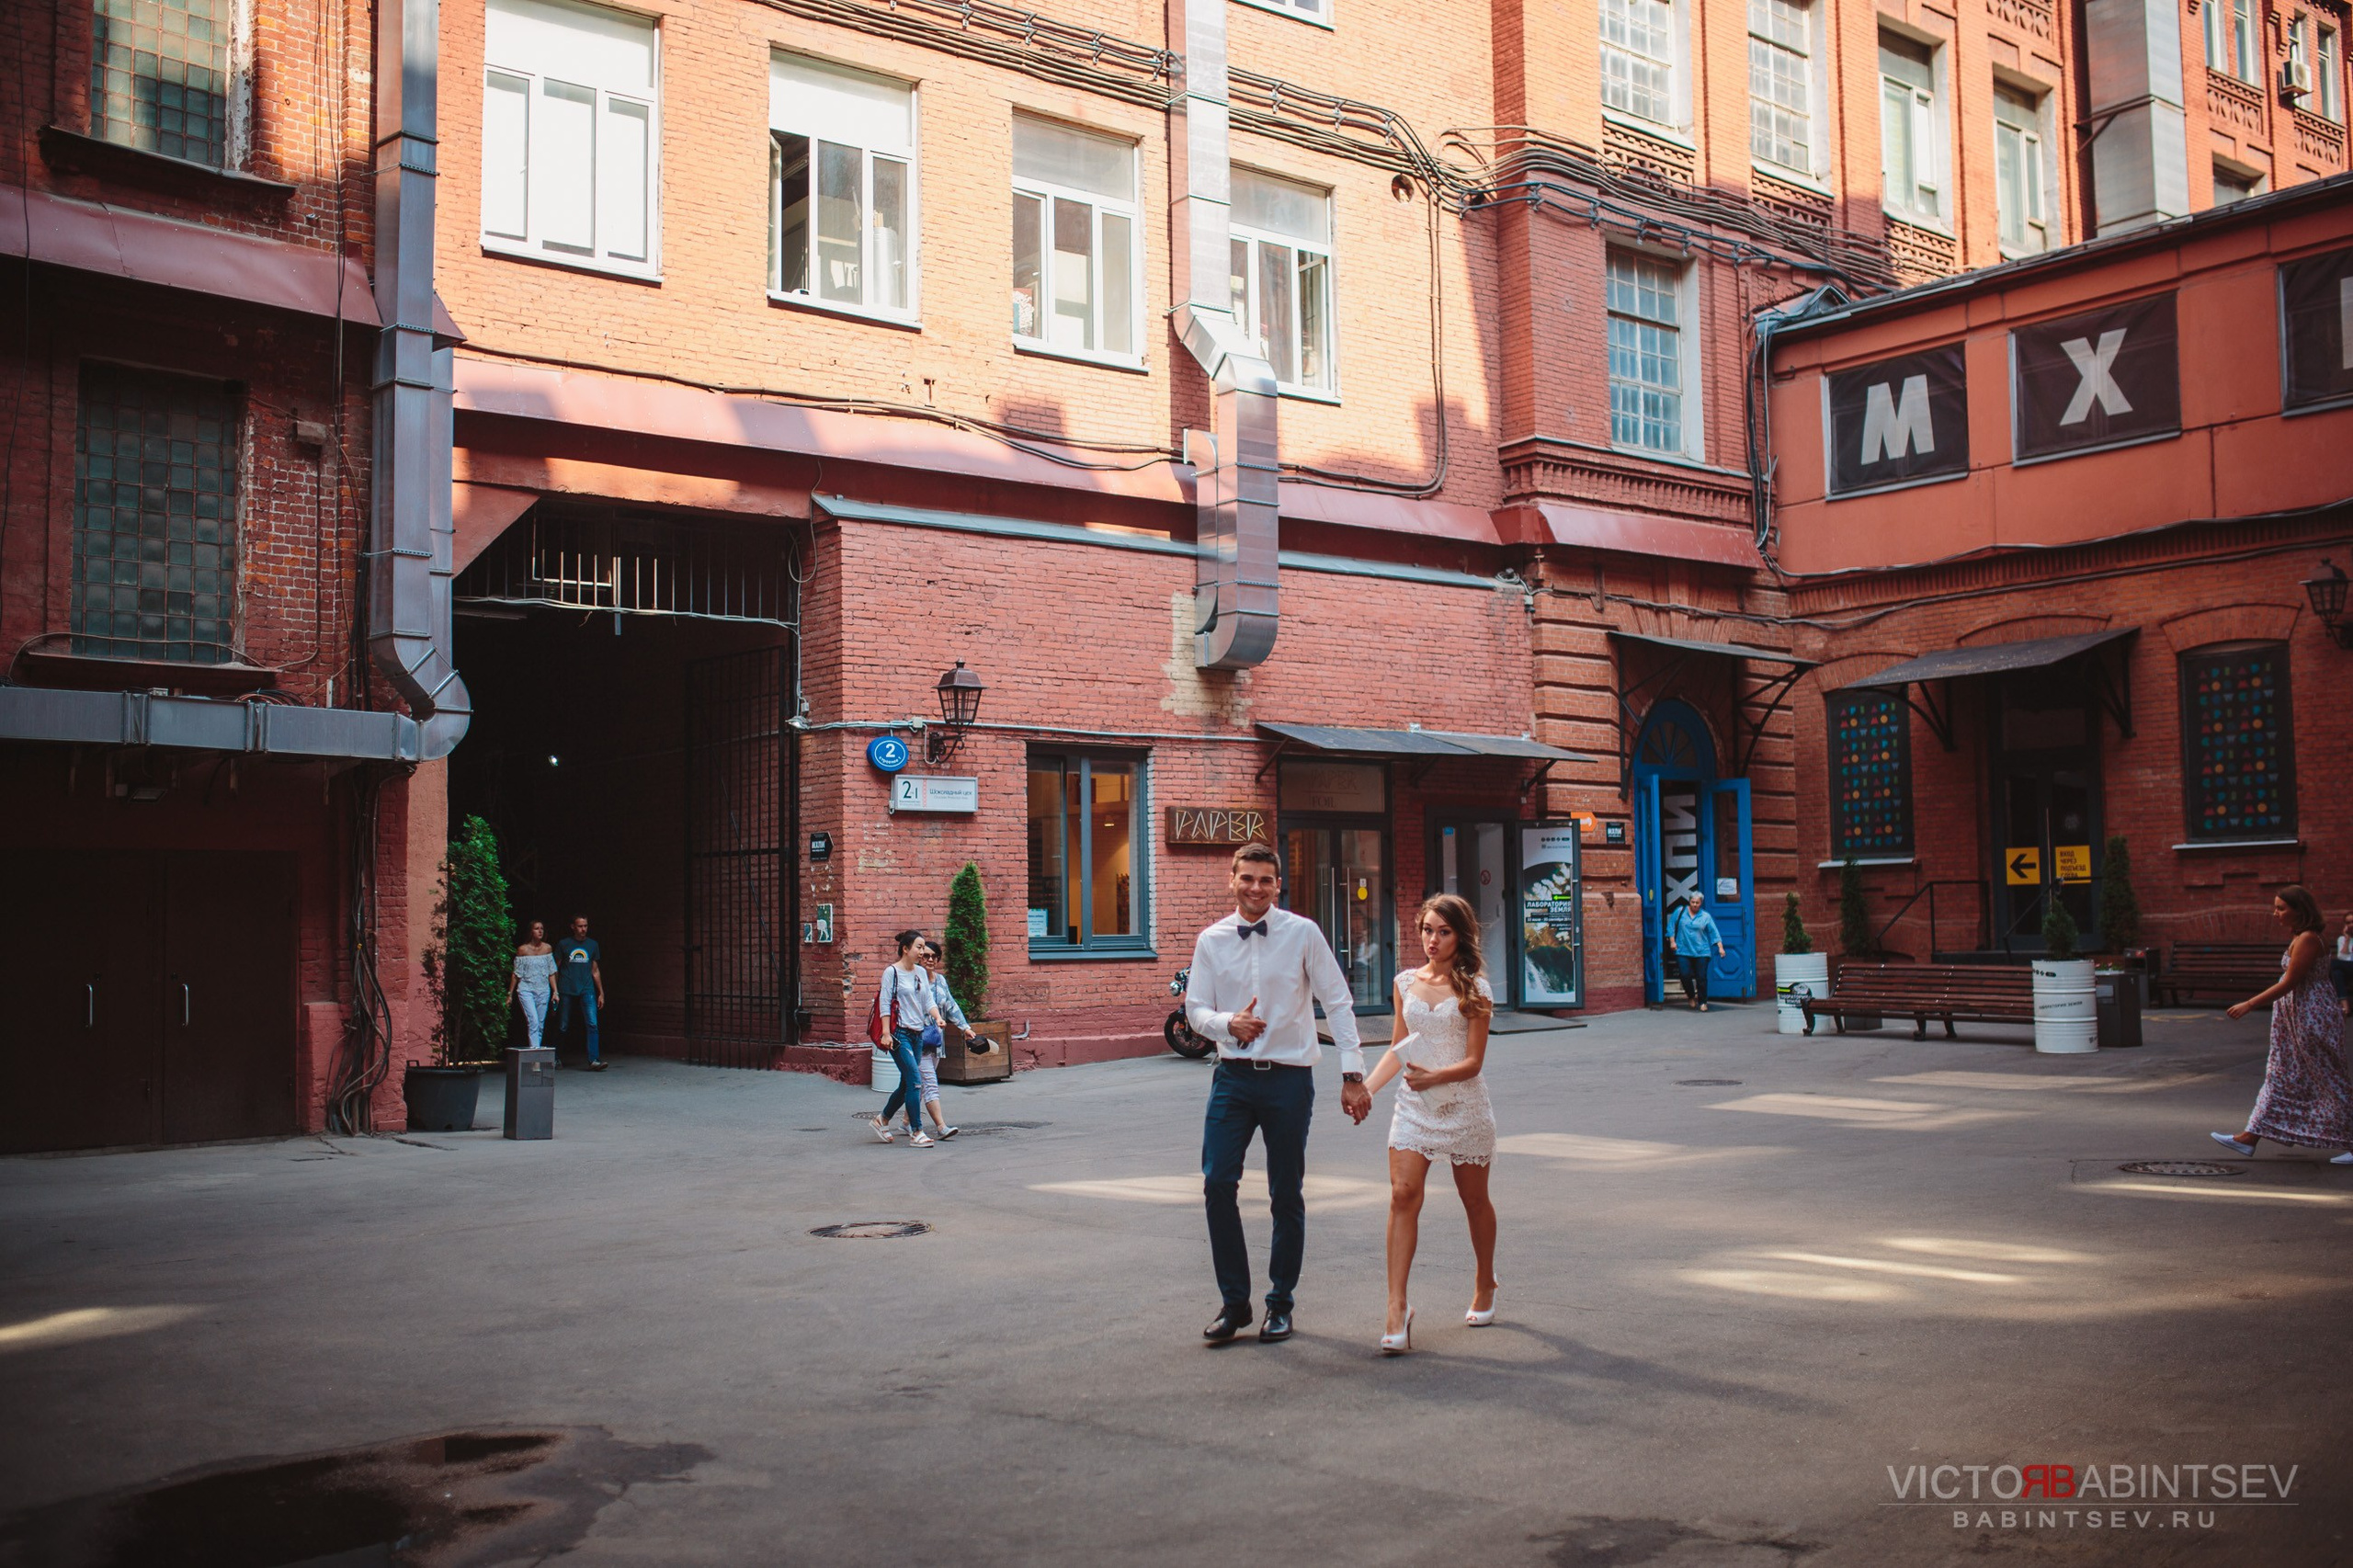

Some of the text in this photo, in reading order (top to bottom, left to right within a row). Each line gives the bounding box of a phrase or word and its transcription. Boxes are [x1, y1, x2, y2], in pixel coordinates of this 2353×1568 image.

[885, 743, 896, 758] 2
[902, 780, 912, 799] 2
[1176, 810, 1267, 841] PAPER
